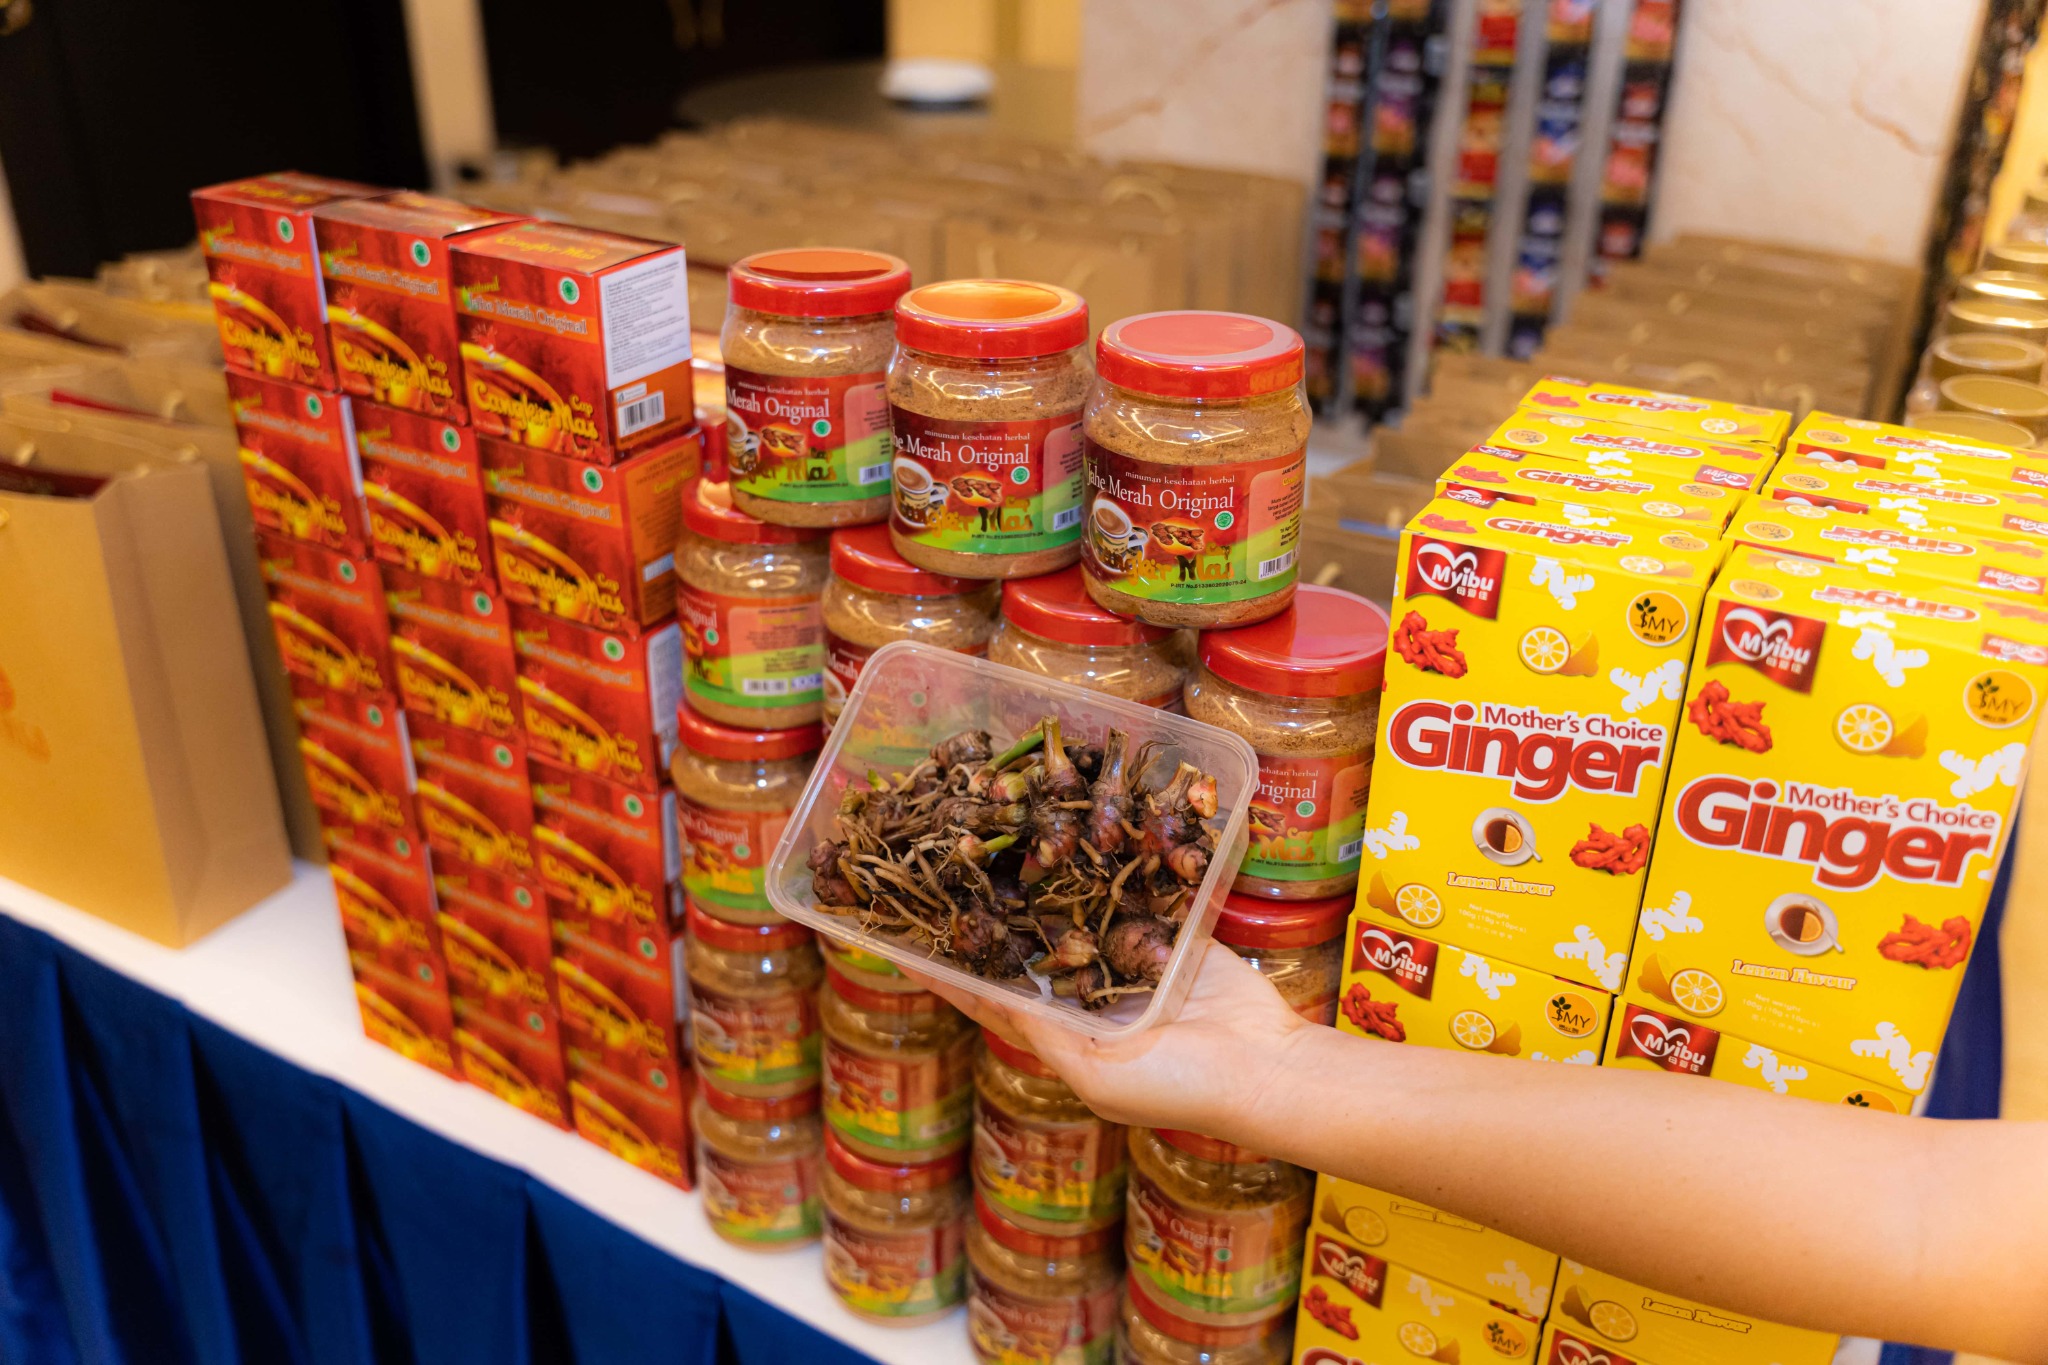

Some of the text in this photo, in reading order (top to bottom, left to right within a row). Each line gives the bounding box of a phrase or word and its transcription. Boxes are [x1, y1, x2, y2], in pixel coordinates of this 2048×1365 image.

[469, 292, 588, 335] Jahe Merah Original
[764, 397, 831, 426] Original
[924, 429, 1031, 442] minuman kesehatan herbal
[906, 434, 952, 463] Merah
[958, 443, 1030, 472] Original
[1087, 463, 1106, 491] Jahe
[1108, 474, 1153, 507] Merah
[1159, 487, 1235, 519] Original
[1125, 471, 1236, 486] minuman kesehatan herbal
[1515, 469, 1654, 495] Ginger
[1485, 517, 1633, 548] Ginger
[1540, 521, 1632, 541] Mother's Choice
[1431, 563, 1495, 592] Myibu
[1737, 629, 1812, 666] Myibu
[1484, 706, 1663, 742] Mother's Choice
[1389, 701, 1661, 801] Ginger
[1292, 769, 1319, 777] herbal
[1789, 785, 1996, 831] Mother's Choice
[1677, 776, 1992, 890] Ginger
[1447, 871, 1556, 897] Lemon Flavour
[1374, 947, 1429, 977] Myibu
[1731, 958, 1858, 991] Lemon Flavour
[1644, 1033, 1707, 1067] Myibu
[1330, 1257, 1378, 1287] Myibu
